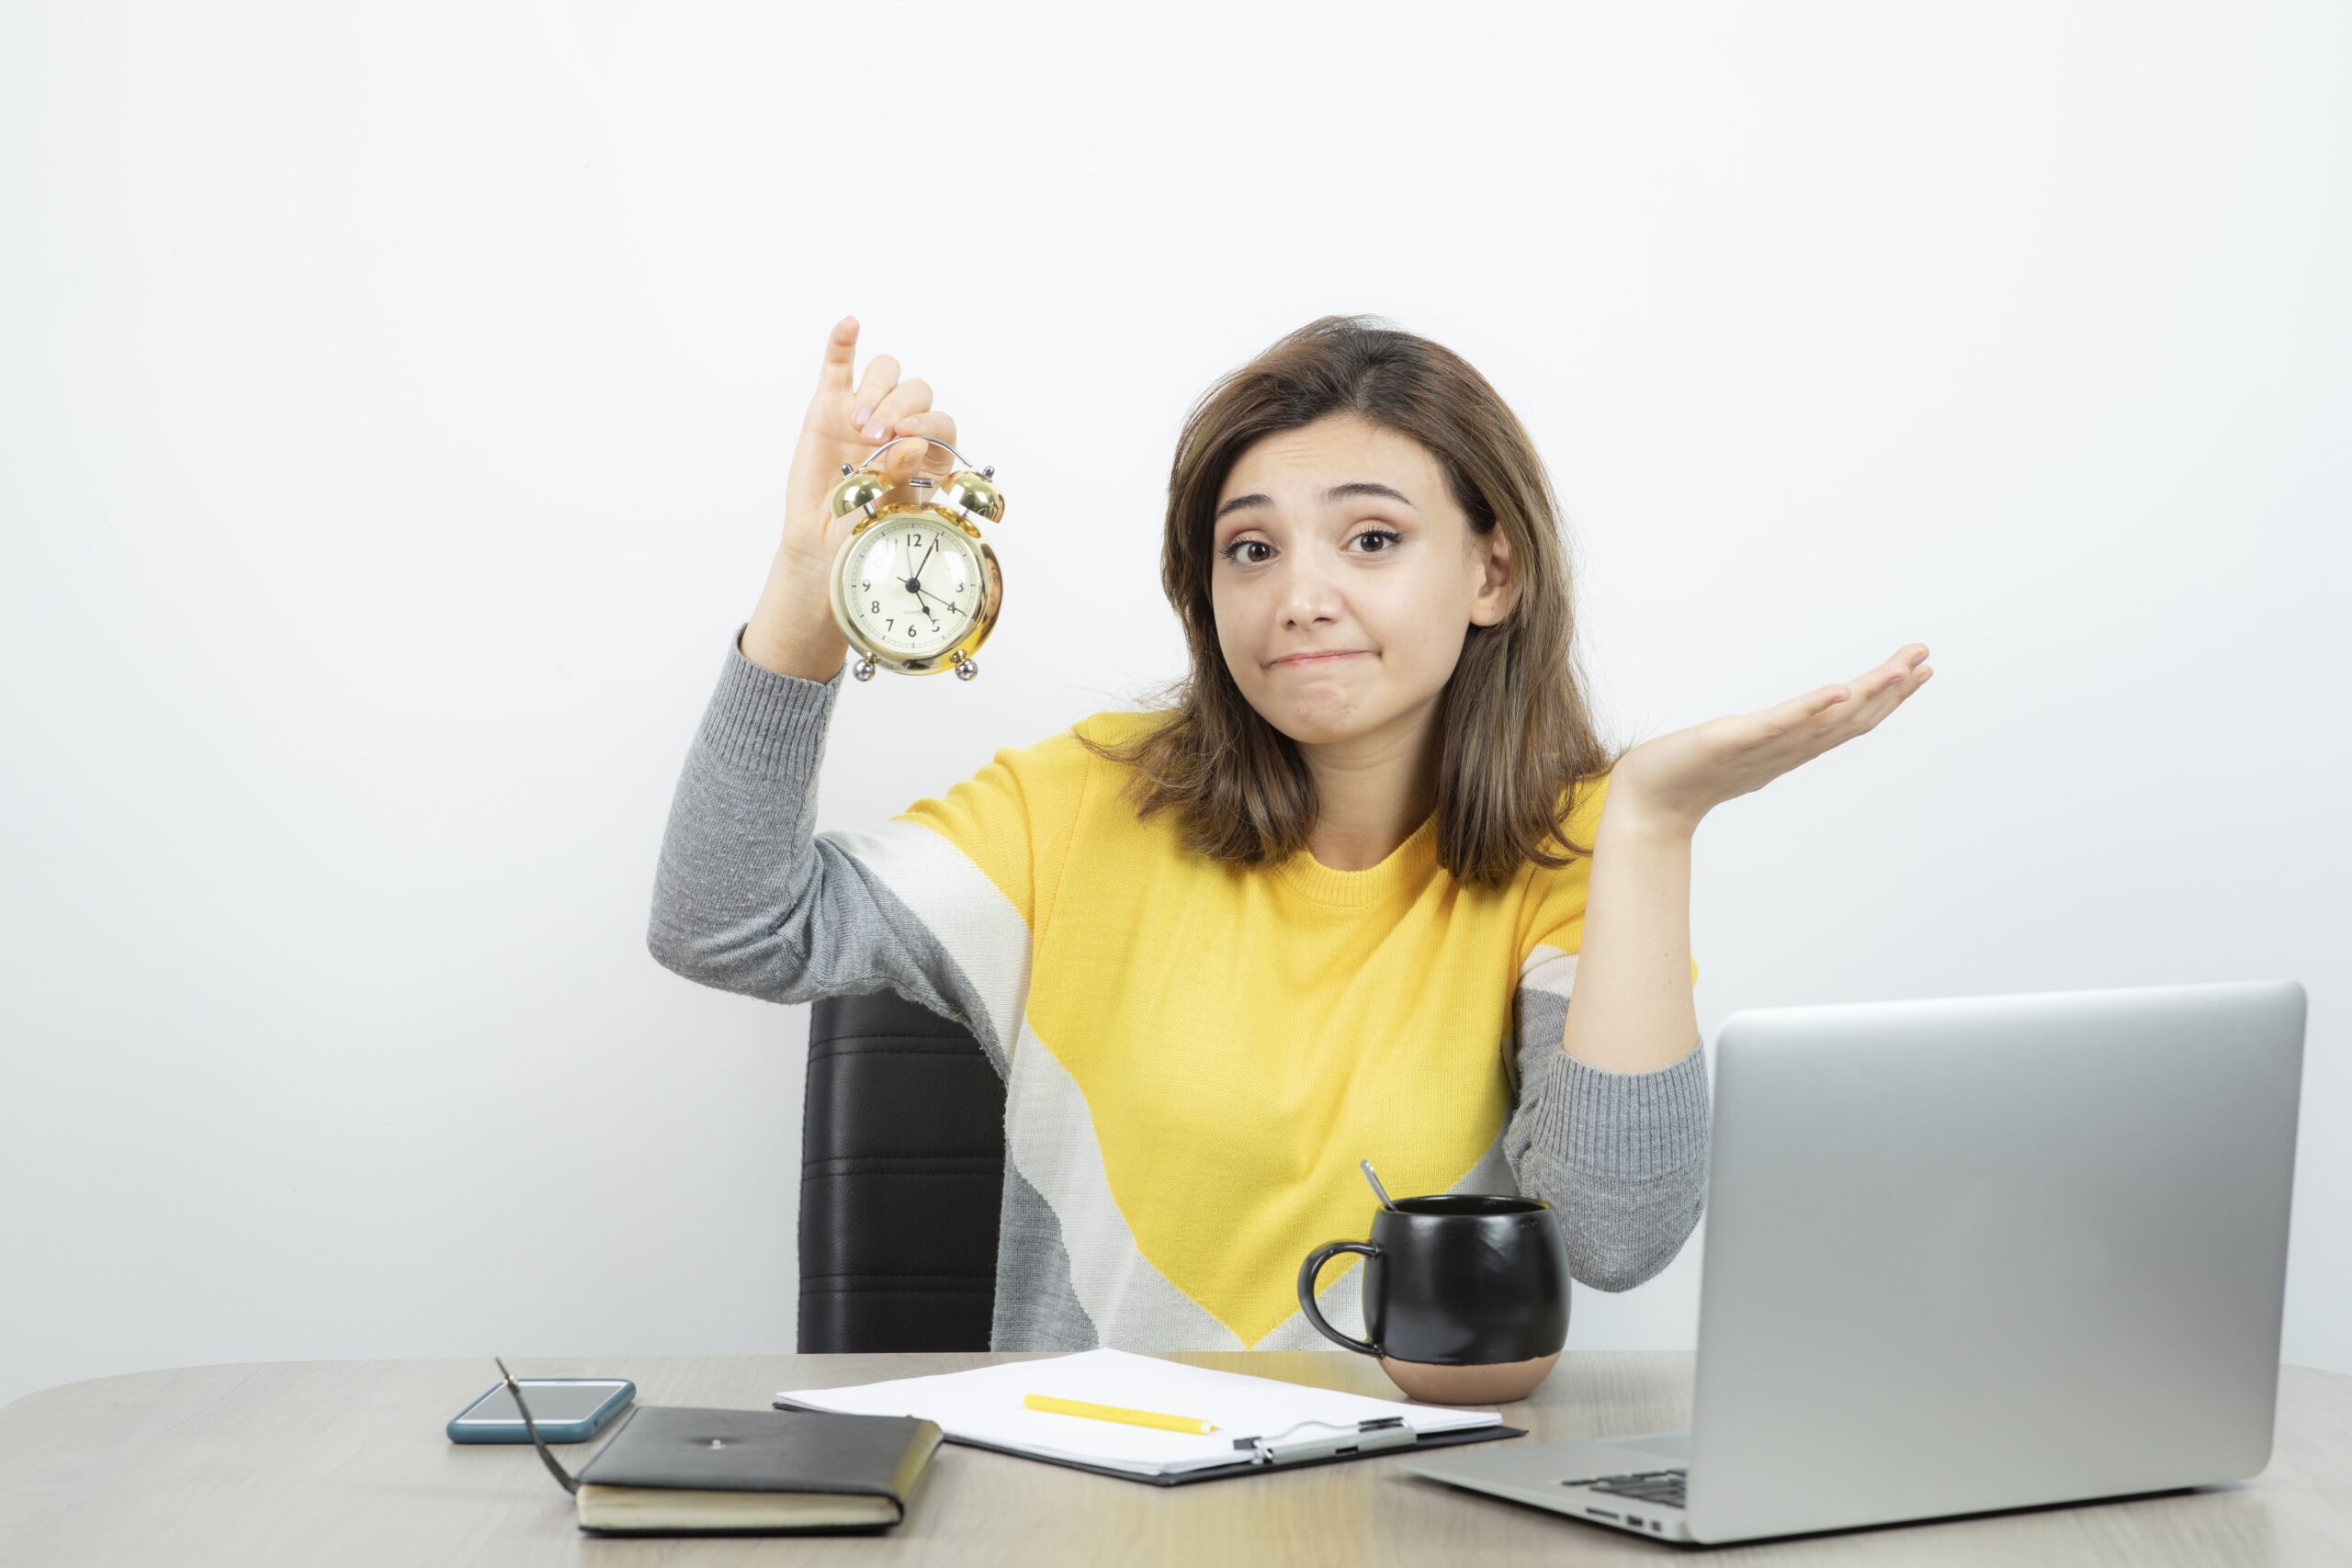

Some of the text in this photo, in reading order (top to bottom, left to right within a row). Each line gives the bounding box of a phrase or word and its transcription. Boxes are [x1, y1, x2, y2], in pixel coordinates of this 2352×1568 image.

[886, 538, 898, 551] 11
[907, 534, 922, 547] 12
[934, 539, 940, 552] 1
[862, 580, 871, 592] 9
[956, 581, 965, 593] 3
[871, 601, 880, 614] 8
[947, 601, 956, 615] 4
[886, 619, 895, 632] 7
[908, 625, 917, 637] 6
[932, 619, 941, 632] 5
